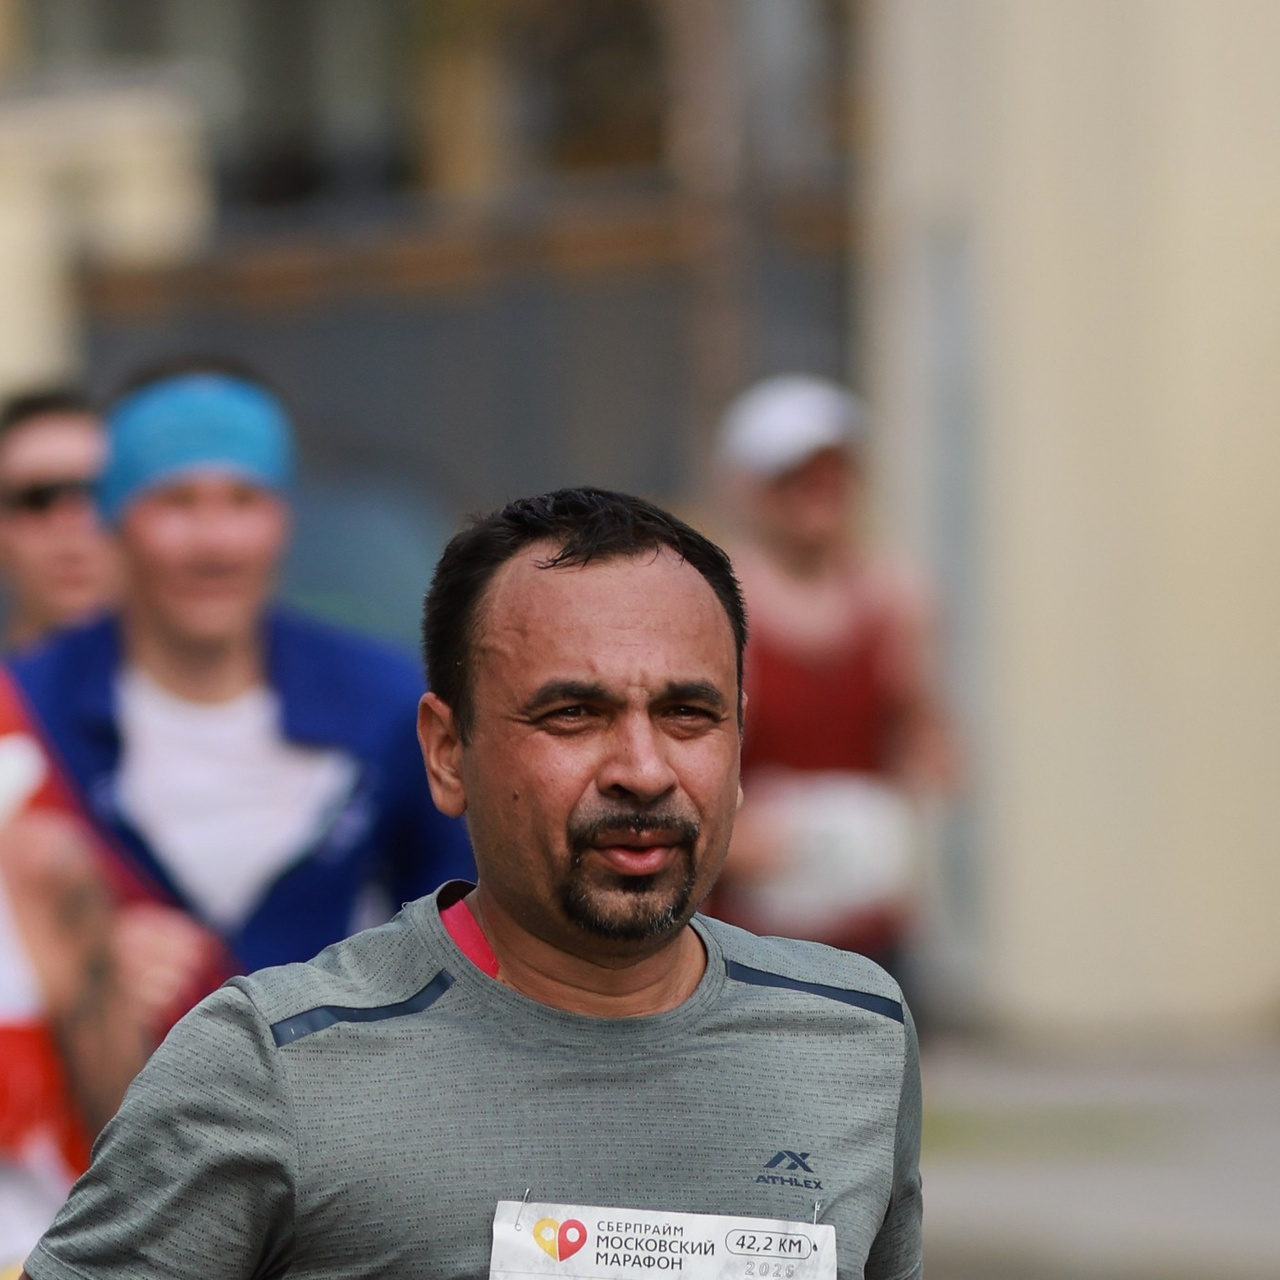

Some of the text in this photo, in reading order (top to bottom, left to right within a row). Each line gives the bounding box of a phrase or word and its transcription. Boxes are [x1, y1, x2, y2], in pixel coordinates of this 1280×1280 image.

[755, 1174, 824, 1190] ATHLEX
[596, 1220, 684, 1237] СБЕРПРАЙМ
[596, 1235, 716, 1256] МОСКОВСКИЙ
[735, 1234, 803, 1254] 42,2 КМ
[595, 1252, 684, 1271] МАРАФОН
[744, 1260, 796, 1279] 2026
